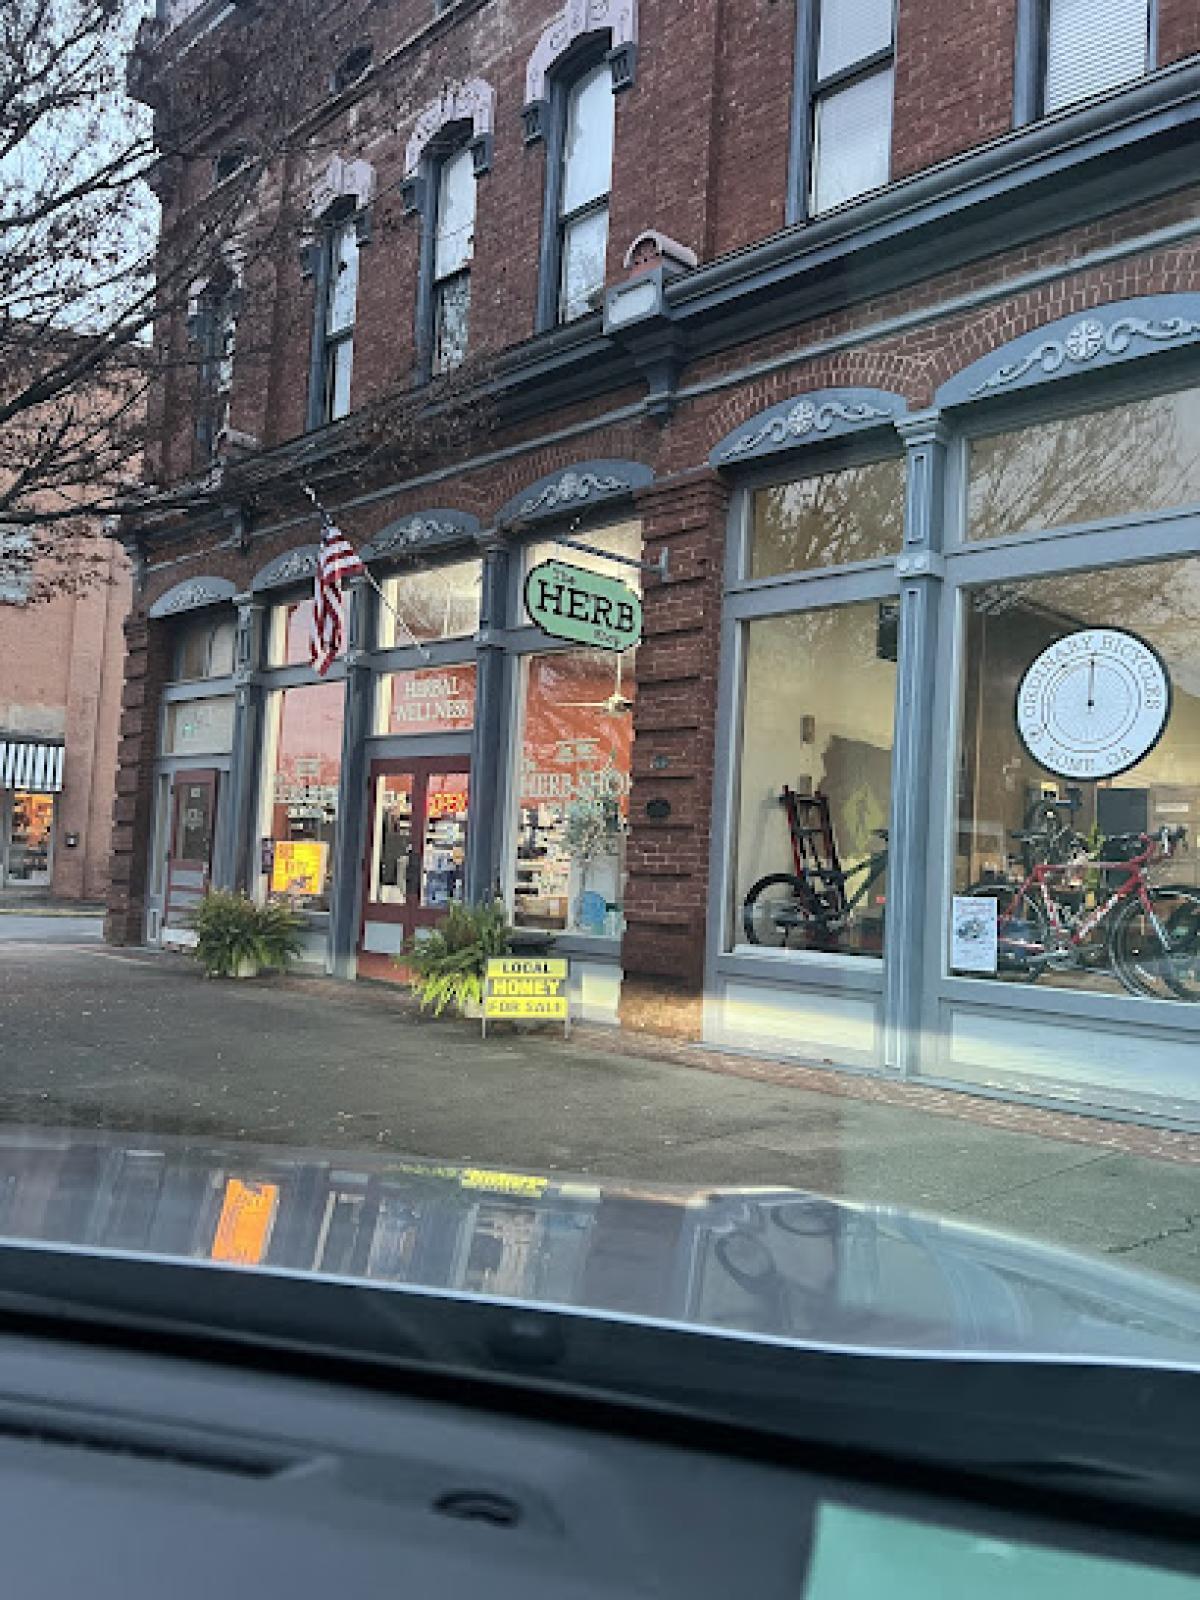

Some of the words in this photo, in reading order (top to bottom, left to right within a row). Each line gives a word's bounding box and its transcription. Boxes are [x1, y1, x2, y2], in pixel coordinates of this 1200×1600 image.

[551, 567, 576, 585] The
[536, 579, 634, 633] HERB
[405, 675, 460, 698] HERBAL
[1023, 634, 1094, 718] ORDINARY
[1100, 634, 1162, 711] BICYCLES
[394, 699, 468, 722] WELLNESS
[427, 792, 468, 817] OPEN
[502, 961, 552, 975] LOCAL
[492, 978, 561, 996] HONEY
[486, 1001, 520, 1014] FOR
